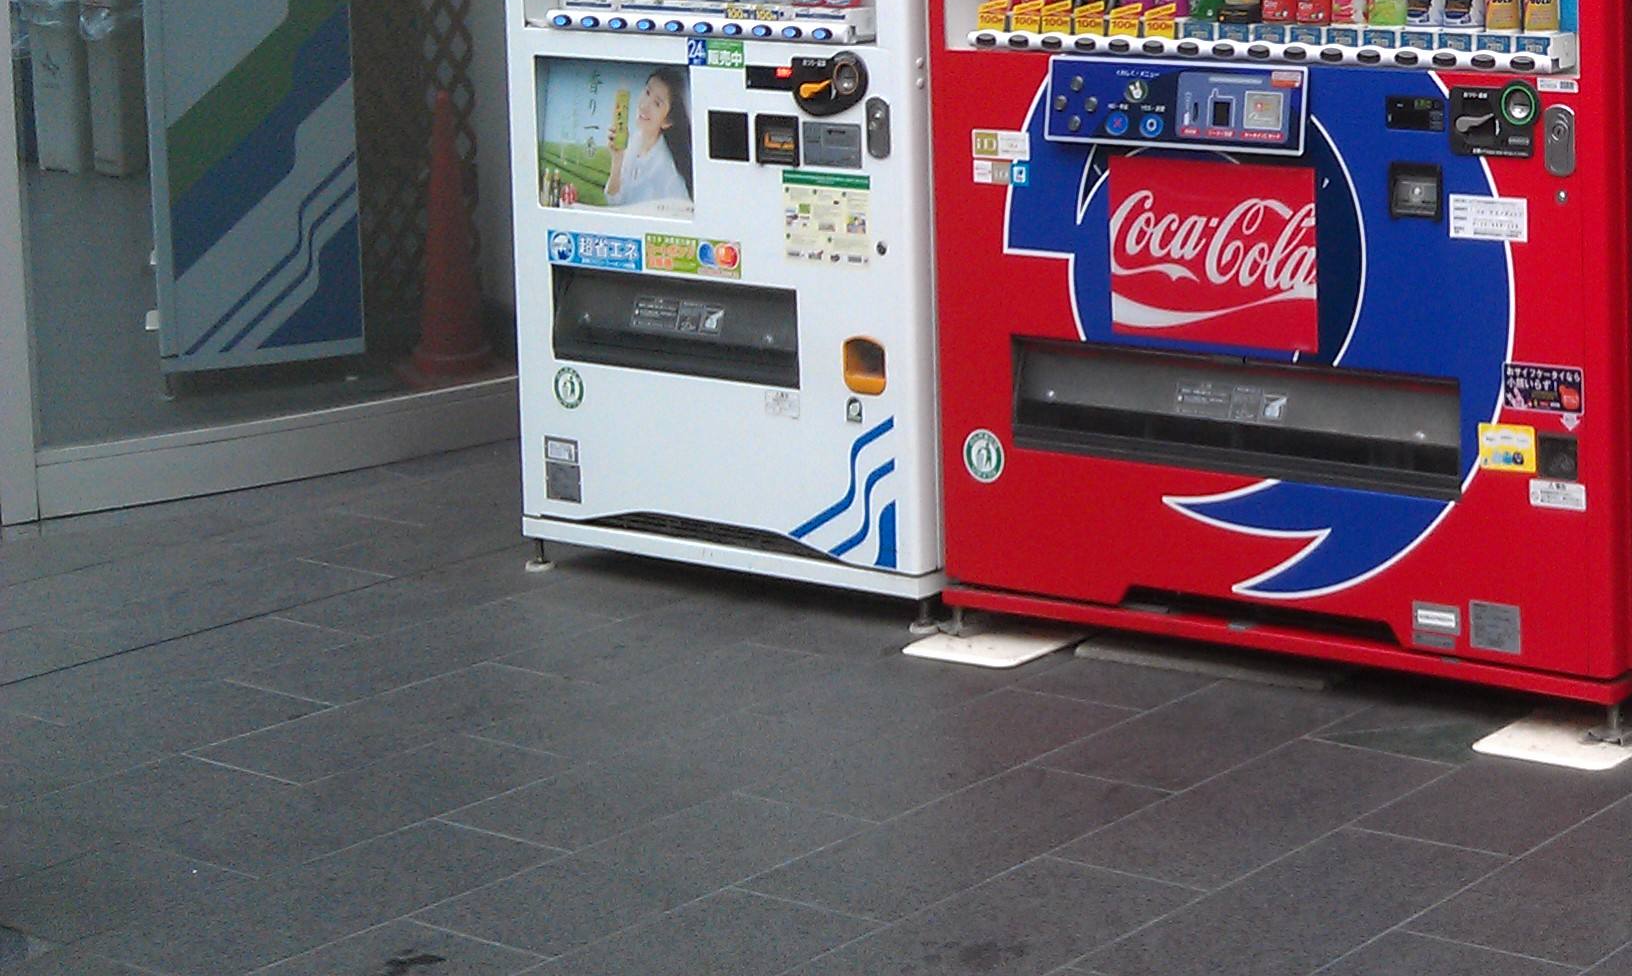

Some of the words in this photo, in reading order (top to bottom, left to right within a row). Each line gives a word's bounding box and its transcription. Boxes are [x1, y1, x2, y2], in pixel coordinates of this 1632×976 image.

[707, 48, 744, 67] 販売中
[579, 237, 639, 259] 超省エネ
[1111, 189, 1316, 290] Coca-Cola
